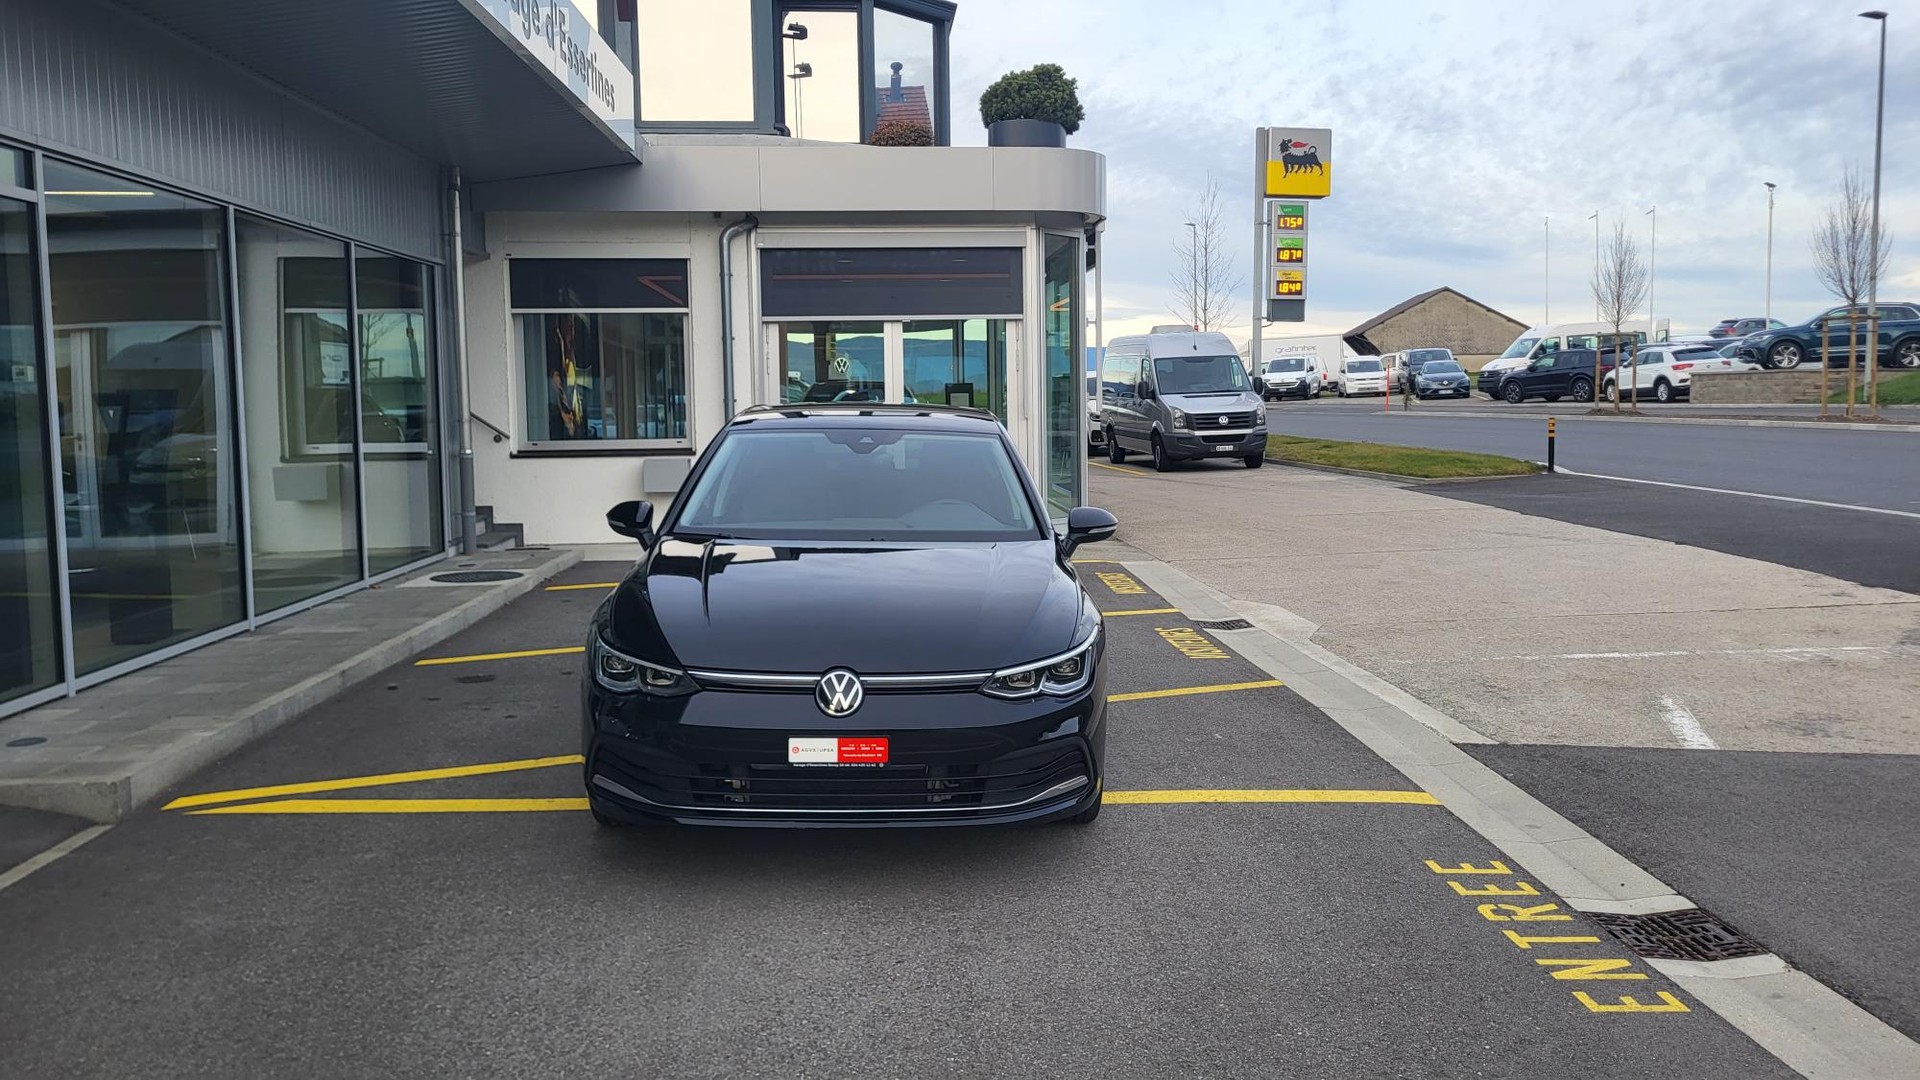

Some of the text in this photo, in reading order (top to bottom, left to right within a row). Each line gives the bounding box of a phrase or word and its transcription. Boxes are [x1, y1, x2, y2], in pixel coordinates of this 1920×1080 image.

[504, 0, 615, 112] age d'Essertines
[1424, 859, 1691, 1013] ENTREE
